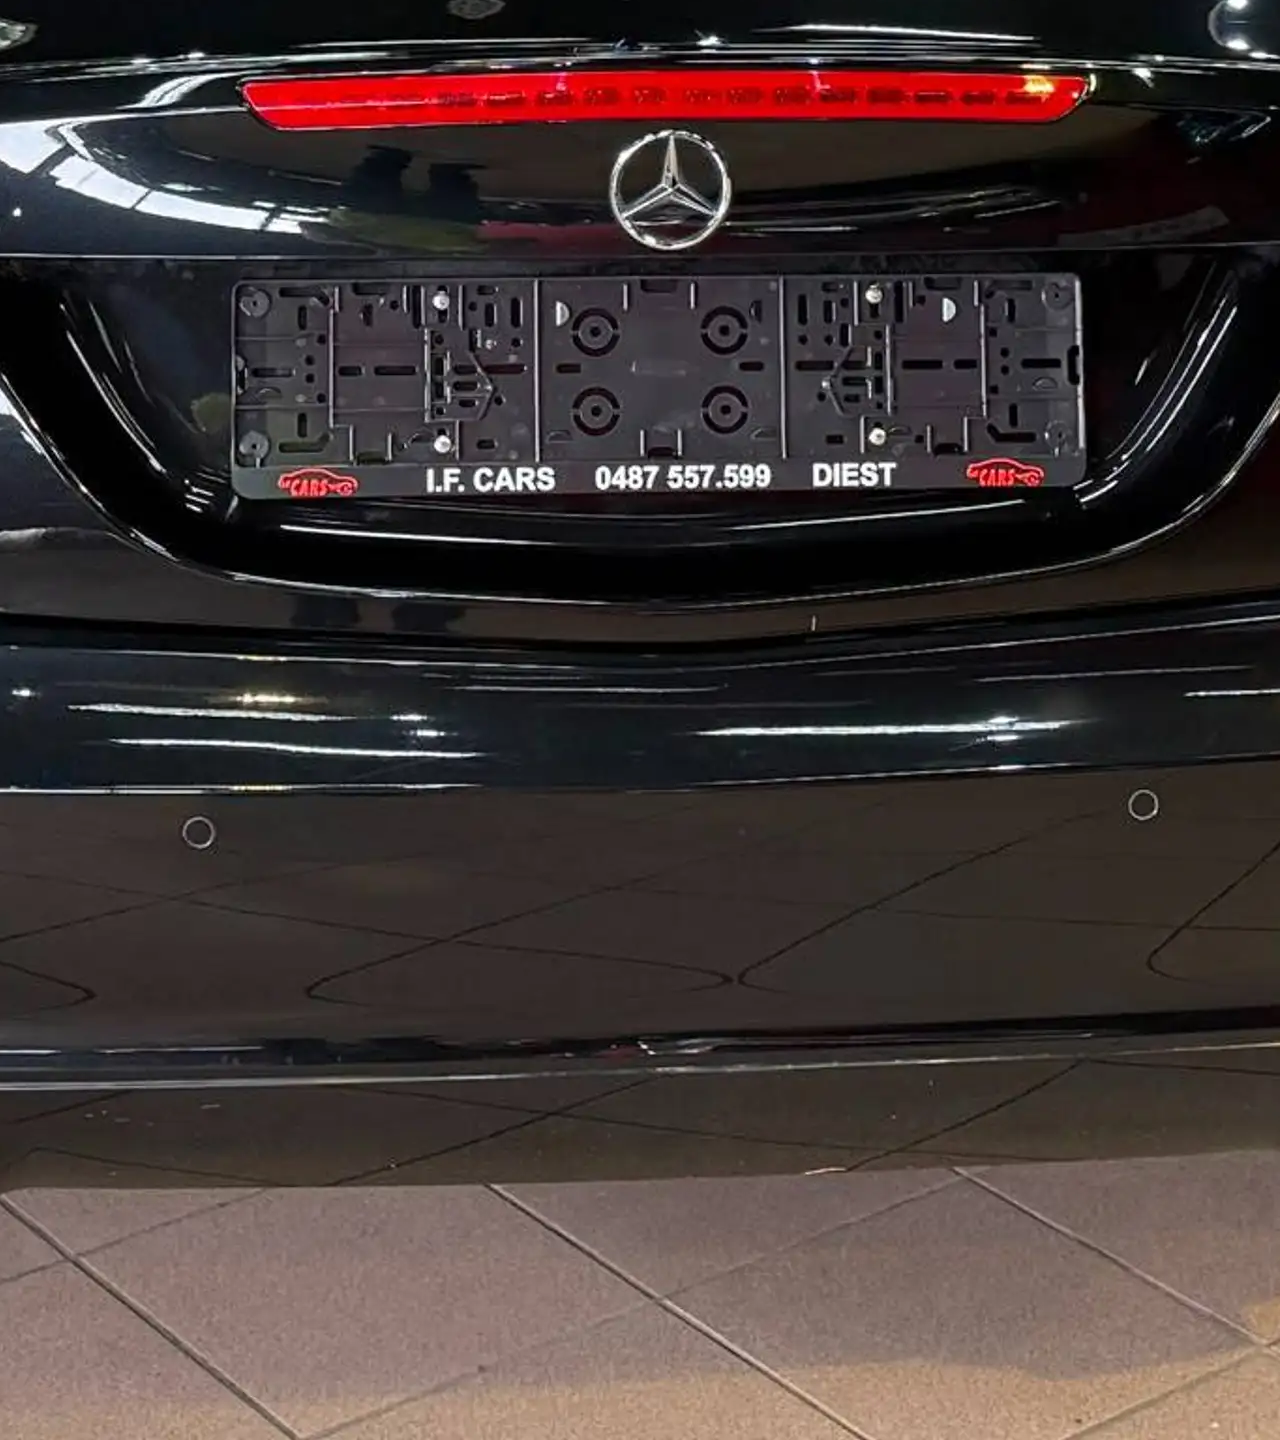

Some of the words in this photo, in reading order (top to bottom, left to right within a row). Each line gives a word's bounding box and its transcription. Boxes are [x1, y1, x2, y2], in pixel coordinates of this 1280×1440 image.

[425, 467, 465, 493] I.F.
[472, 466, 556, 492] CARS
[594, 464, 660, 490] 0487
[666, 463, 772, 490] 557.599
[812, 461, 897, 487] DIEST
[979, 468, 1014, 487] CARS
[290, 478, 329, 497] CARS
